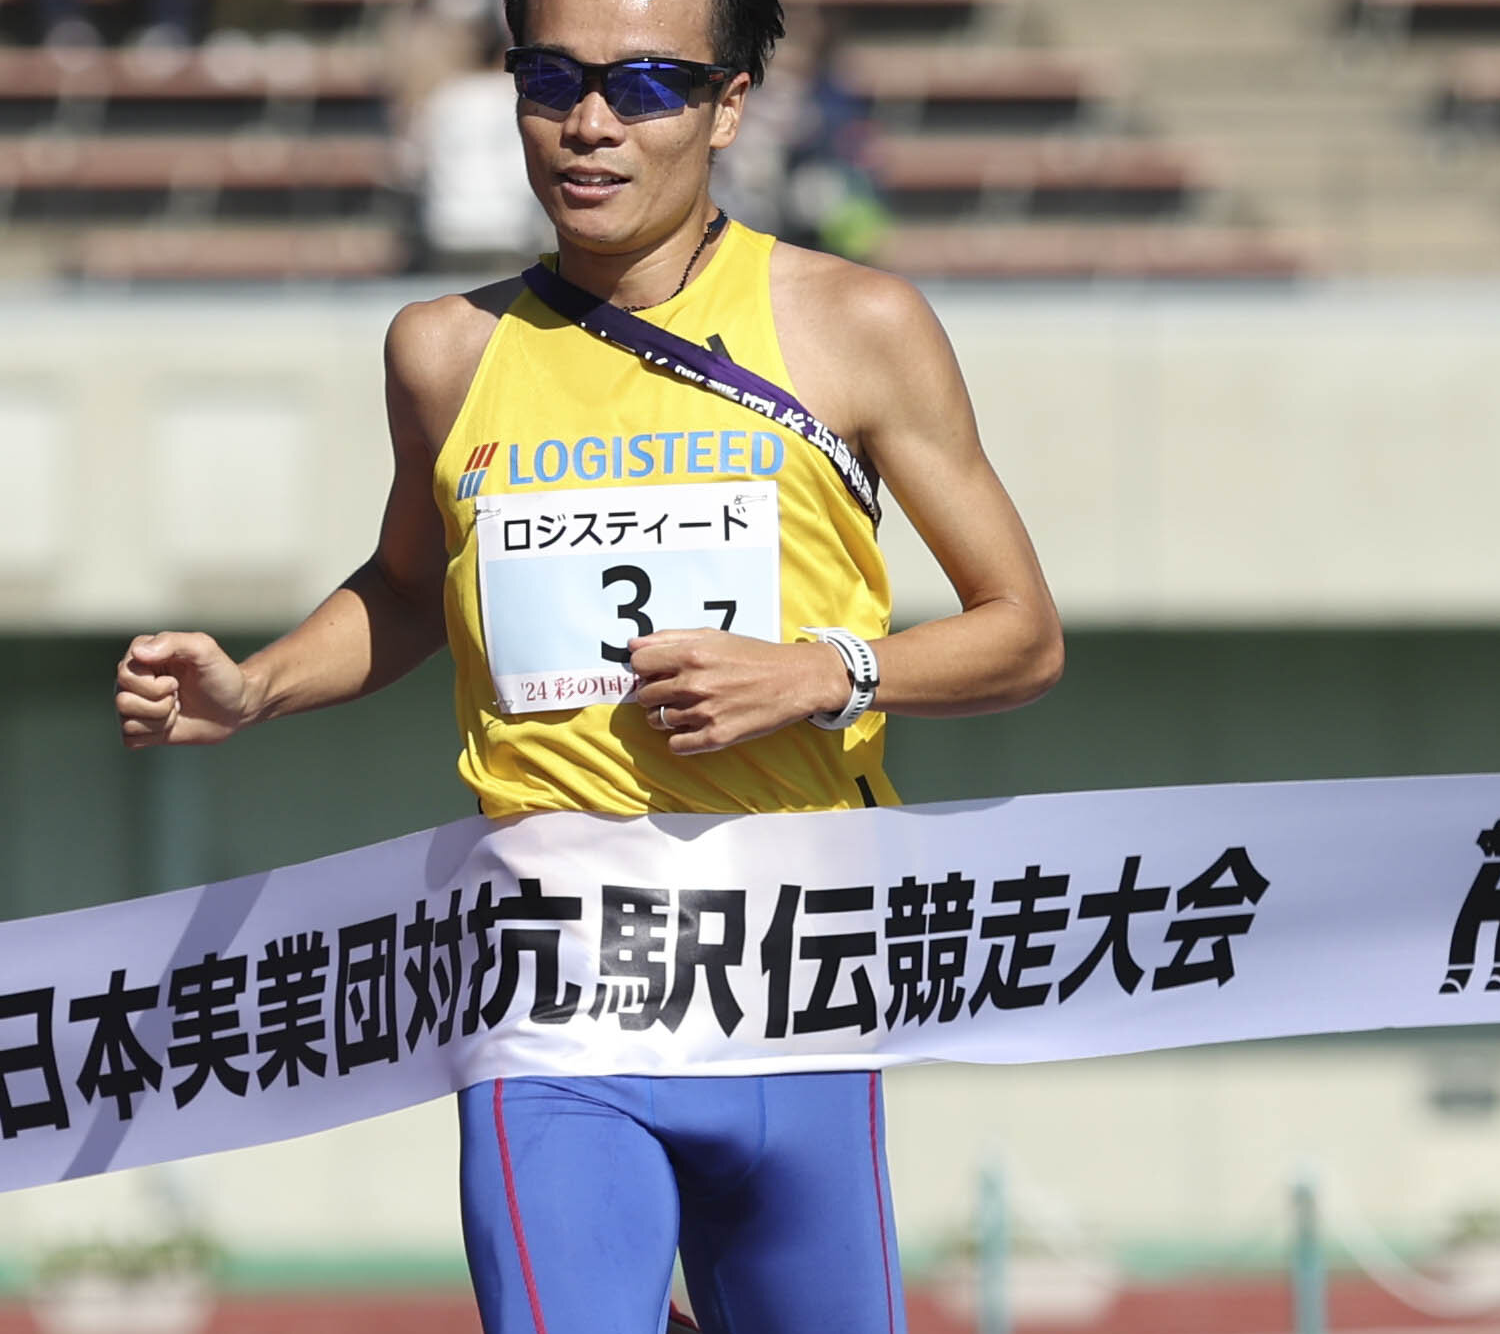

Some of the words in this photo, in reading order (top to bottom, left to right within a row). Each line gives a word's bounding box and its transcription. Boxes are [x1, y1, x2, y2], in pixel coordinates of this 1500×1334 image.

[508, 430, 785, 485] LOGISTEED
[503, 505, 748, 551] ロジスティード
[600, 564, 654, 663] 3
[703, 600, 737, 631] 7
